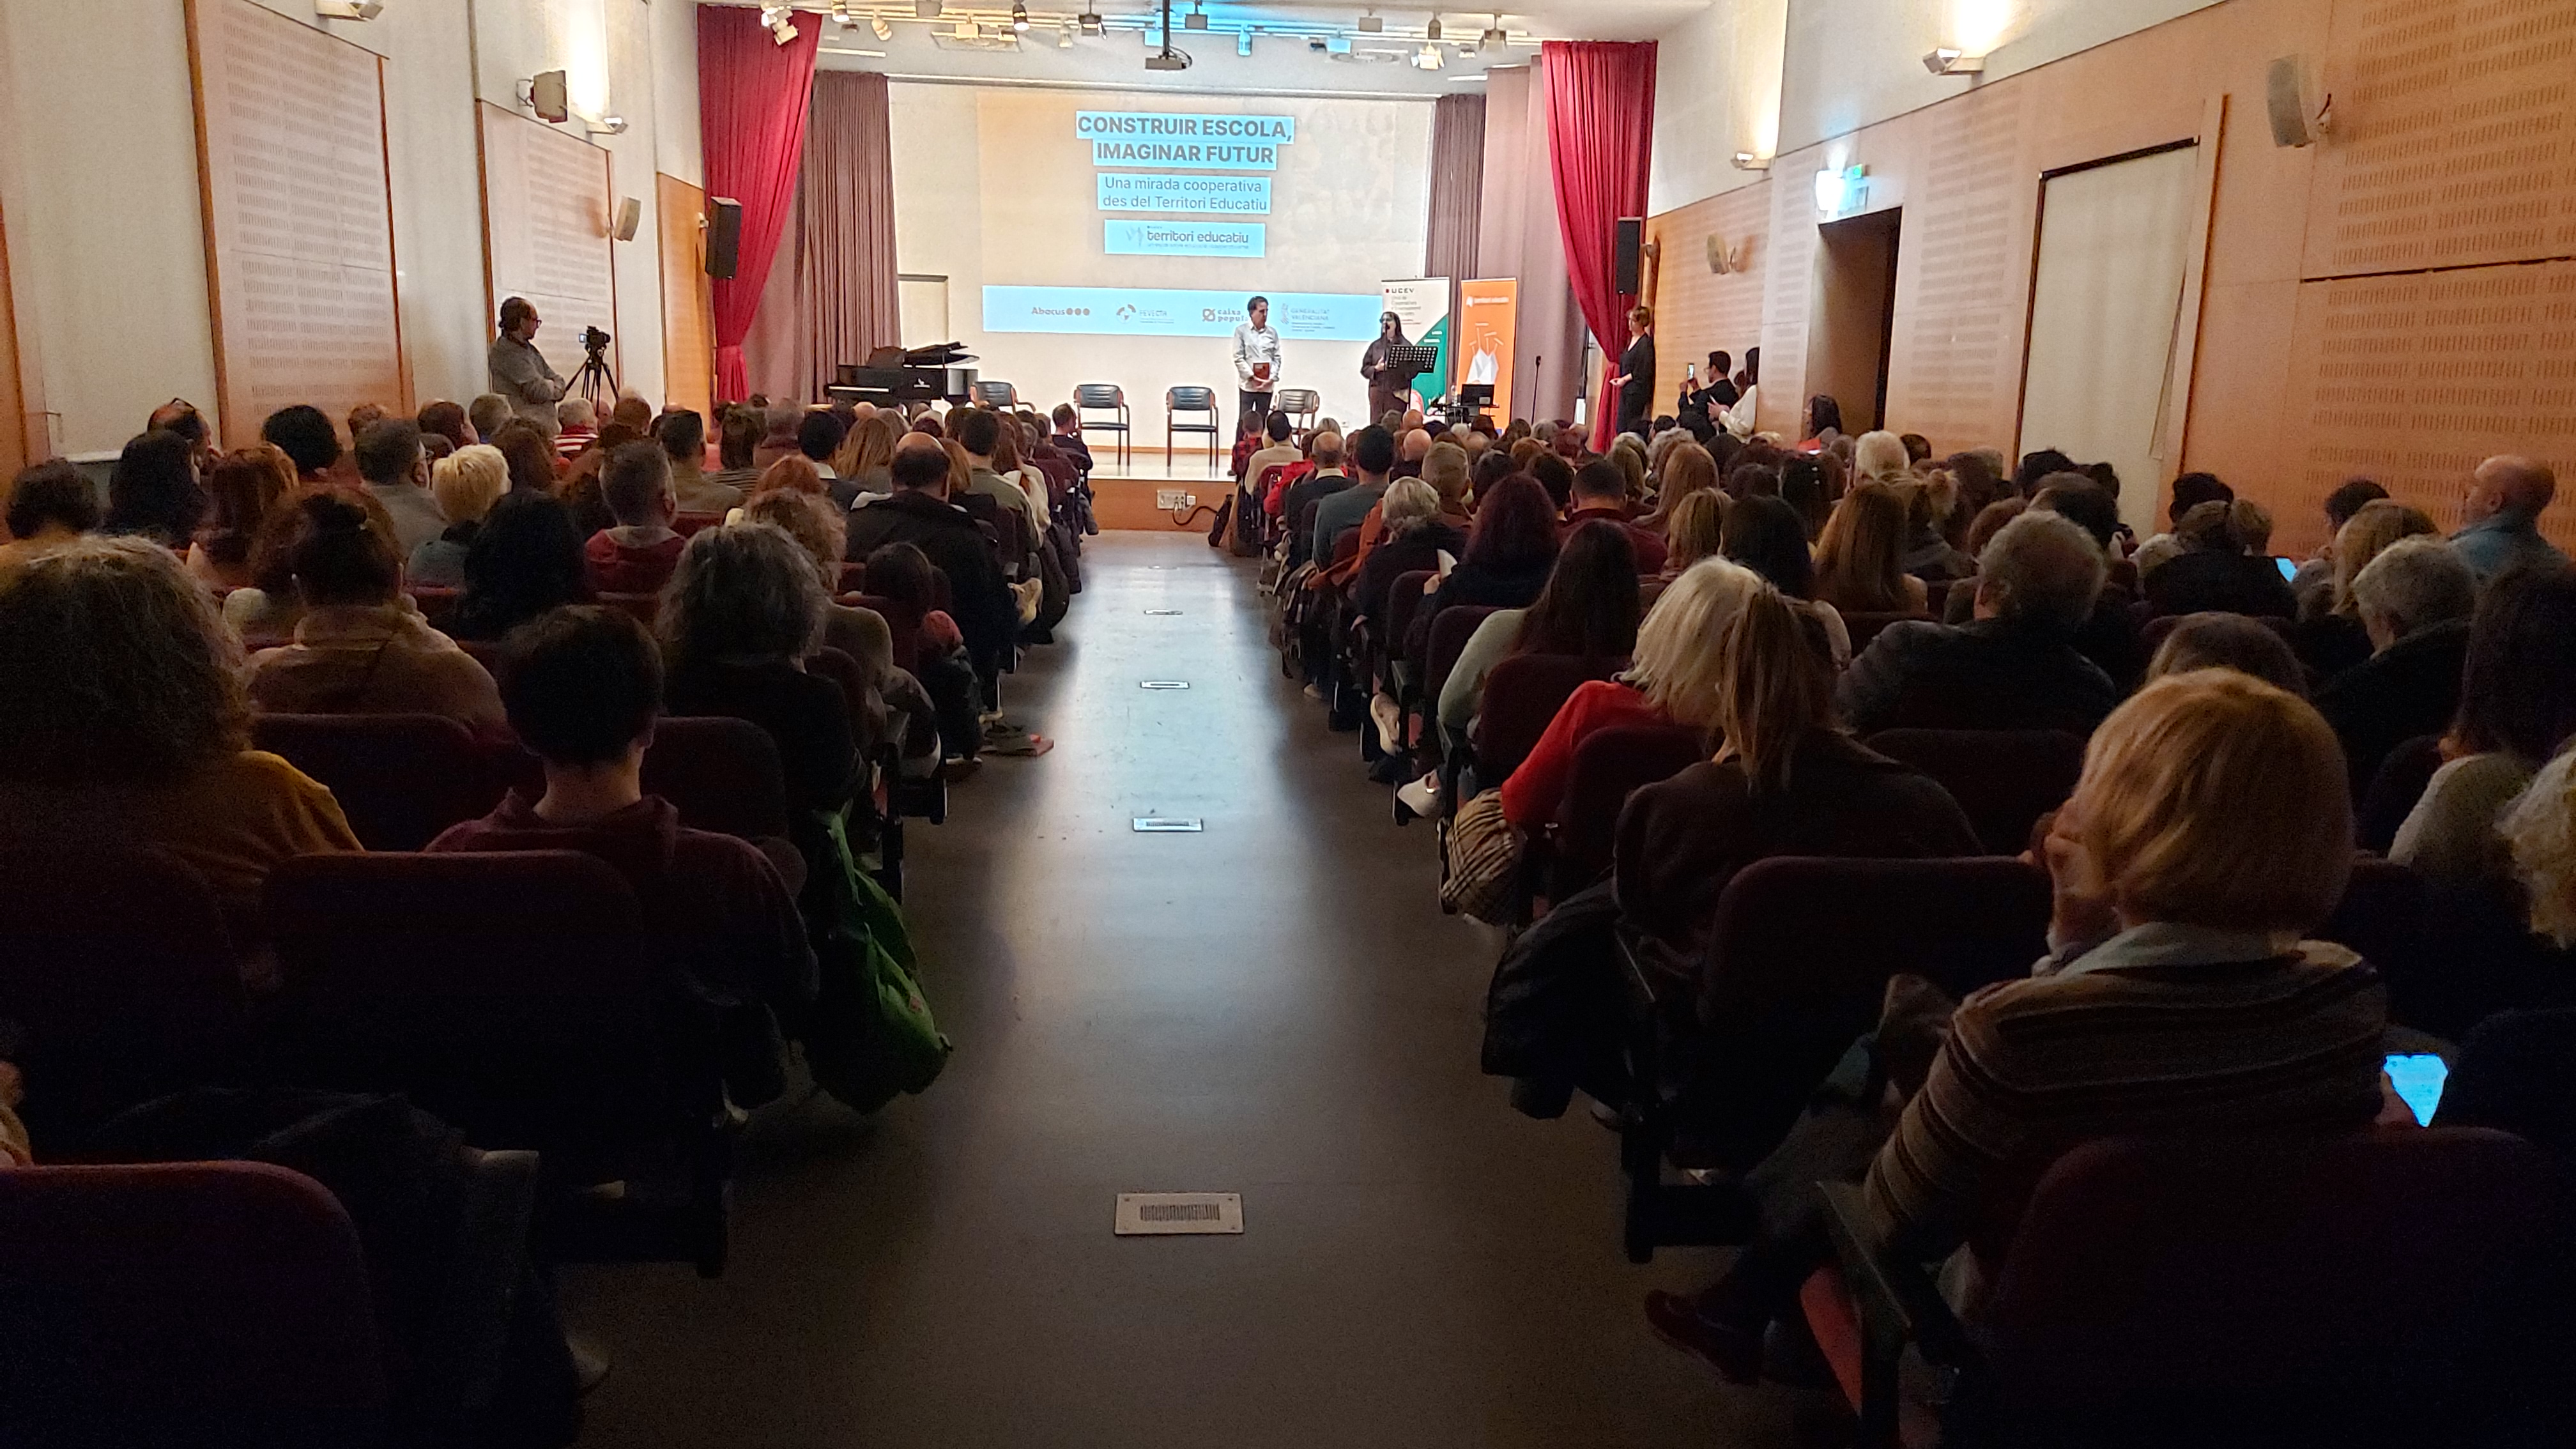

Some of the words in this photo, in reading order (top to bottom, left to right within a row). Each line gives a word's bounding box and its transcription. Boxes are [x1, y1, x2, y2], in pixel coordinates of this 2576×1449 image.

[1077, 116, 1197, 135] CONSTRUIR
[1202, 119, 1292, 142] ESCOLA,
[1097, 142, 1200, 161] IMAGINAR
[1206, 146, 1273, 164] FUTUR
[1105, 176, 1131, 189] Una
[1135, 177, 1180, 191] mirada
[1183, 180, 1262, 194] cooperativa
[1103, 195, 1127, 208] des
[1130, 195, 1151, 208] del
[1154, 196, 1206, 209] Territori
[1209, 197, 1268, 211] Educatiu
[1147, 229, 1194, 242] territori
[1197, 231, 1248, 243] educatiu
[1031, 307, 1066, 316] Abacus
